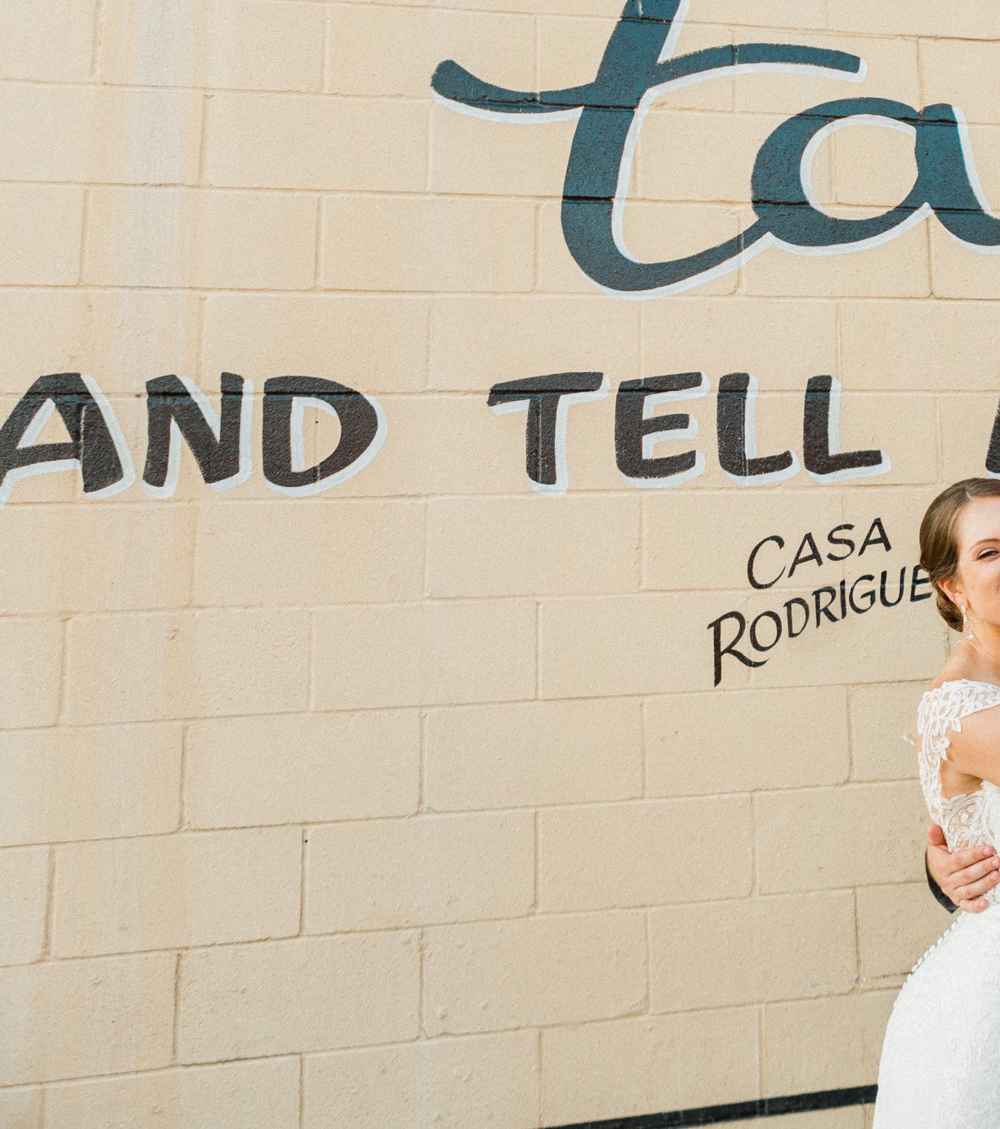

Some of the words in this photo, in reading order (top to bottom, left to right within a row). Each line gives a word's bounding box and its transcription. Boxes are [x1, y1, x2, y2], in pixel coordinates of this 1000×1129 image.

[0, 372, 378, 492] AND
[488, 371, 882, 484] TELL
[747, 517, 892, 589] CASA
[707, 564, 932, 687] RODRIGUE
